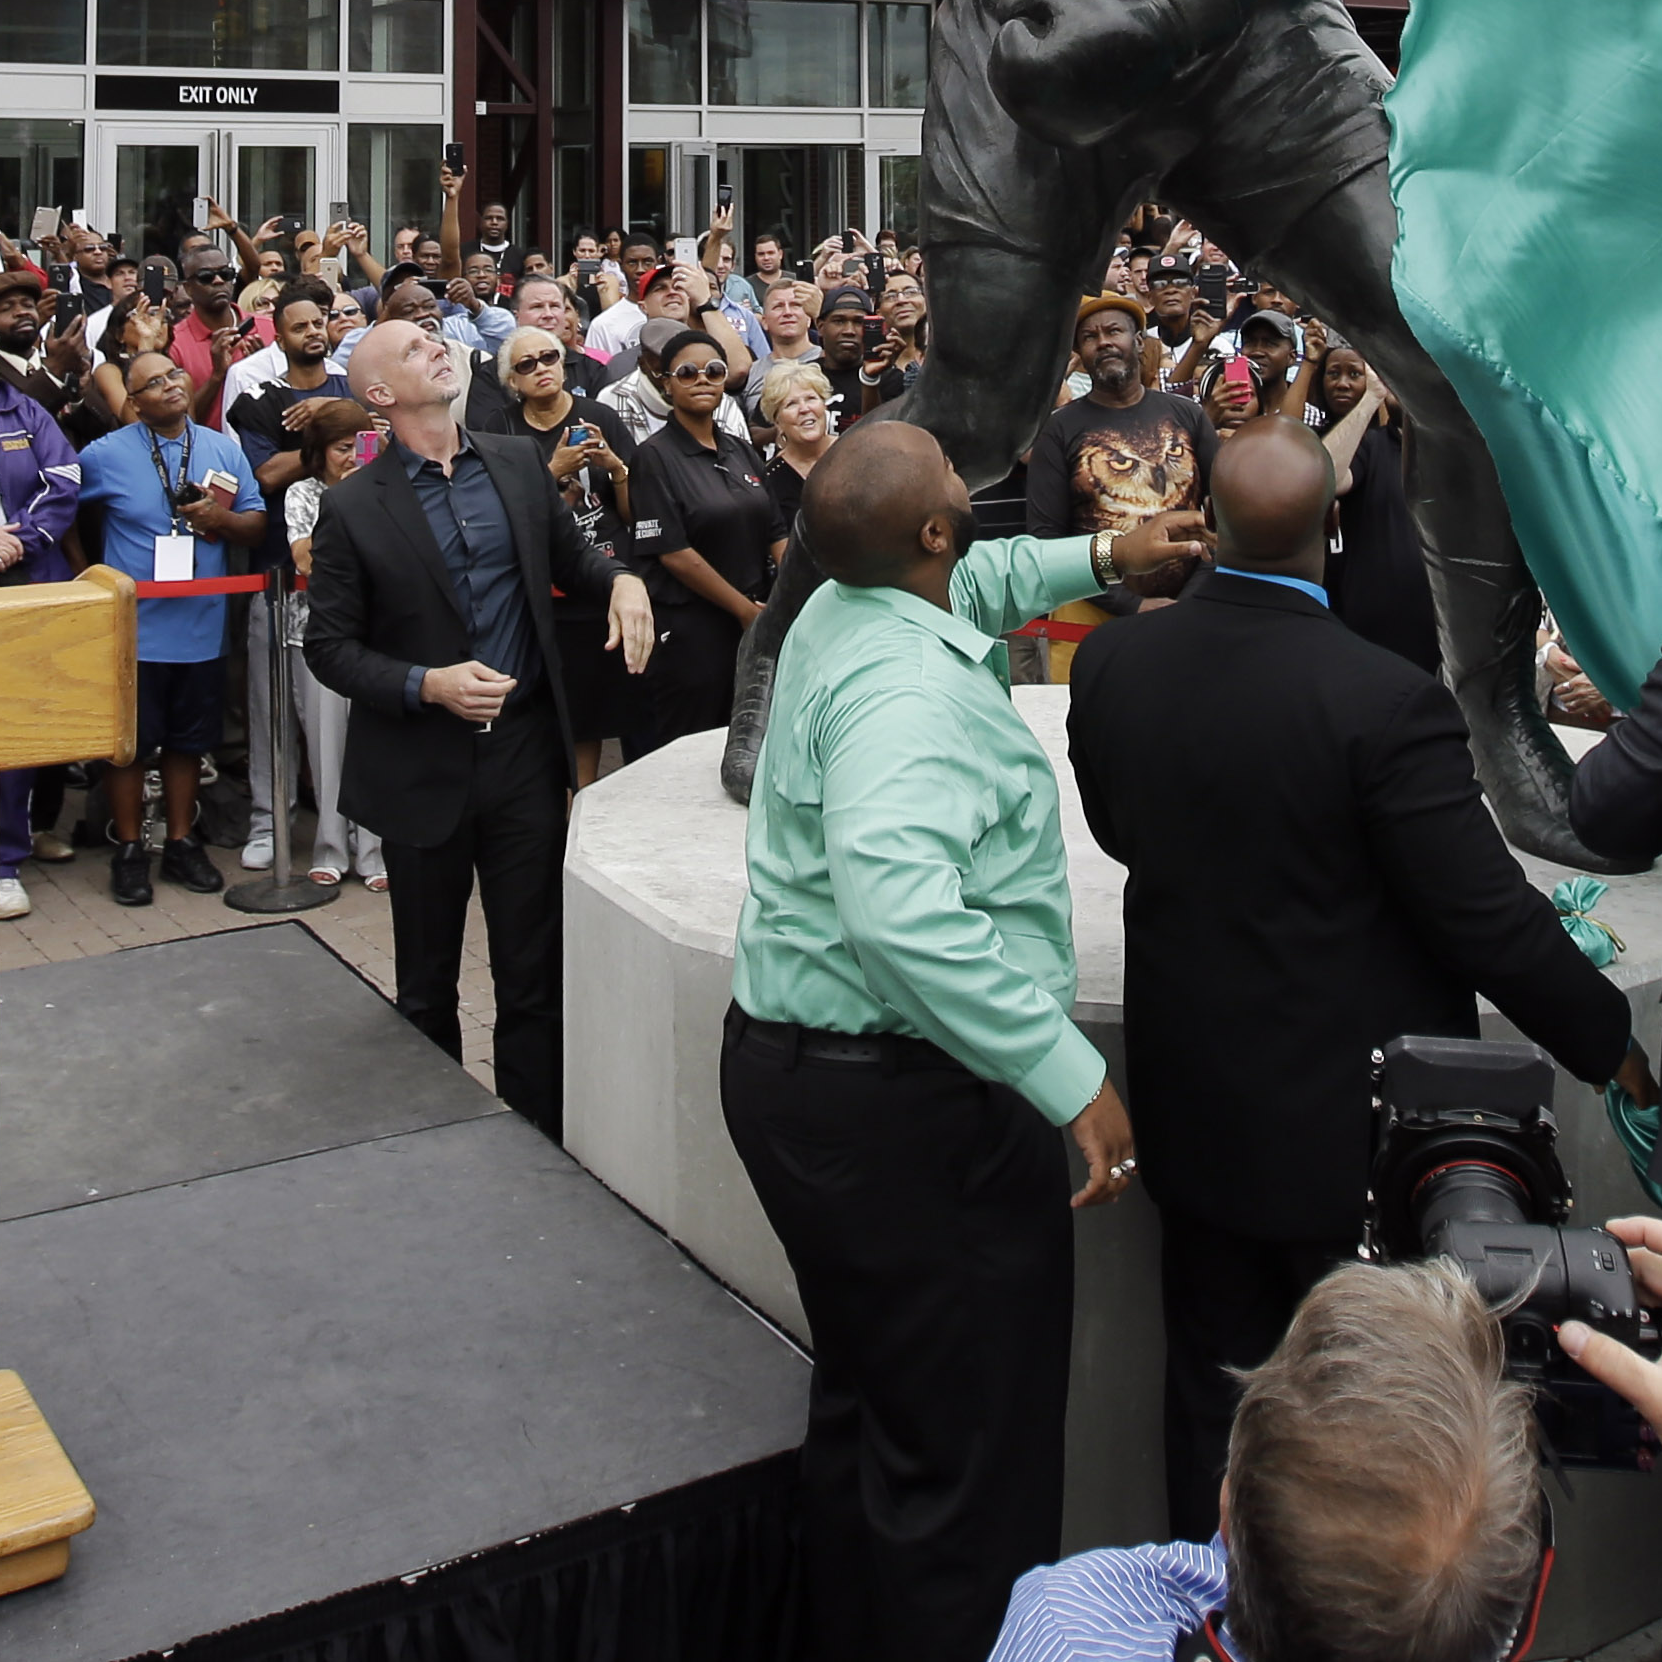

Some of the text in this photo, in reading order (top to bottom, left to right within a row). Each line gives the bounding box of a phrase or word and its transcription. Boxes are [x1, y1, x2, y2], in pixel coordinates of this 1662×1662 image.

[179, 85, 258, 104] EXIT ONLY
[635, 519, 659, 529] PRIVATE
[635, 527, 663, 540] SECURITY
